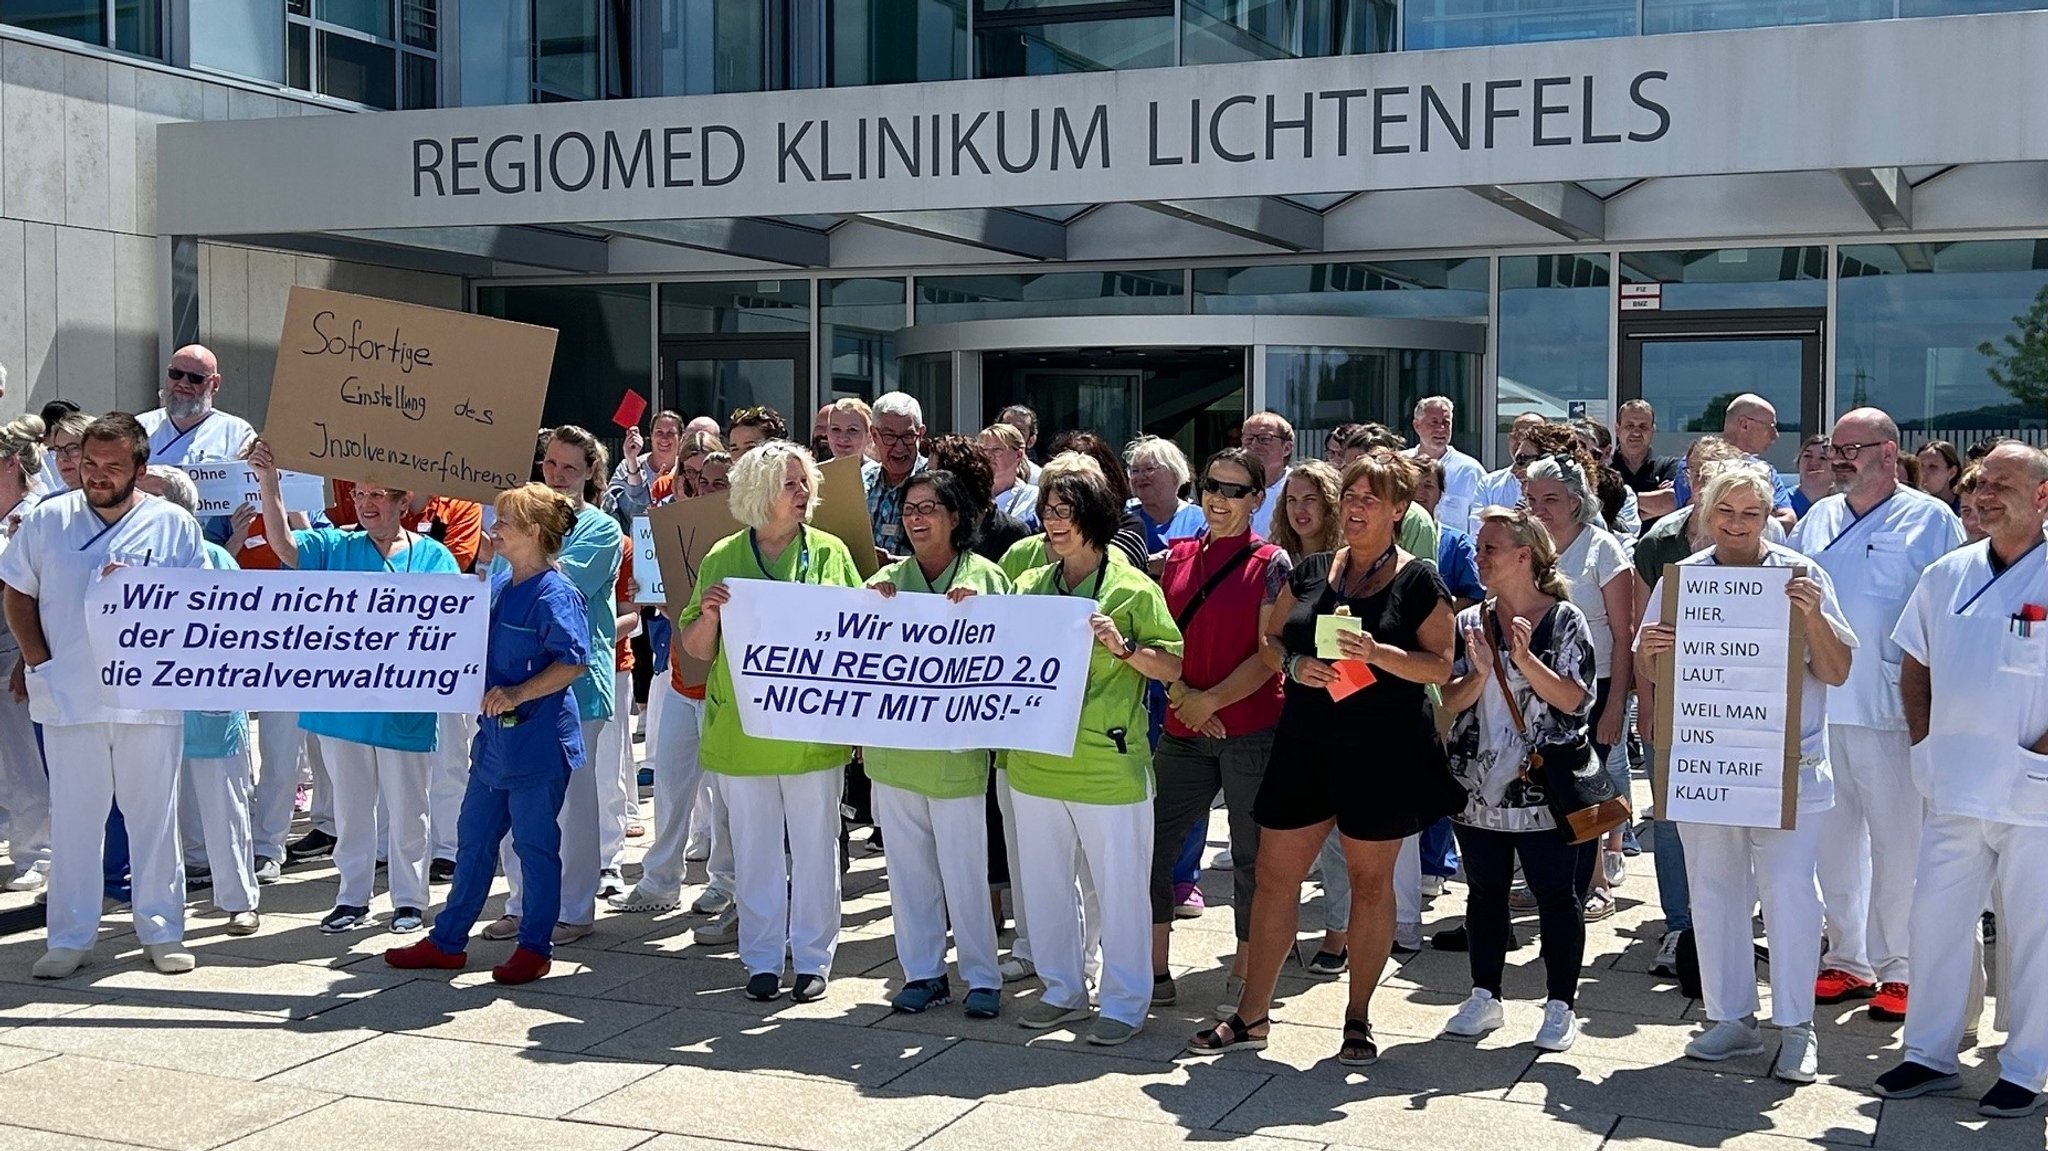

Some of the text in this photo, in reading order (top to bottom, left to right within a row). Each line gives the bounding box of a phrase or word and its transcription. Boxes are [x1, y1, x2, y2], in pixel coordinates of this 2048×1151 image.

[413, 69, 1672, 197] REGIOMED KLINIKUM LICHTENFELS
[301, 311, 433, 373] Sofortige
[341, 376, 493, 425] Einstellung des
[189, 468, 226, 480] Ohne
[196, 499, 230, 511] Ohne
[677, 525, 697, 588] K
[1687, 581, 1762, 595] WIR SIND
[102, 584, 475, 620] „Wir sind nicht länger
[1685, 607, 1725, 623] HIER,
[119, 622, 456, 651] der Dienstleister für
[815, 612, 995, 645] „Wir wollen
[1683, 642, 1759, 656] WIR SIND
[743, 643, 1060, 684] KEIN REGIOMED 2.0
[102, 660, 479, 695] die Zentralverwaltung“
[1683, 668, 1725, 684] LAUT,
[754, 685, 872, 717] -NICHT
[878, 694, 940, 722] MIT
[1681, 703, 1766, 720] WEIL MAN
[1681, 729, 1714, 744] UNS
[1678, 759, 1763, 776] DEN TARIF
[1676, 786, 1729, 801] KLAUT
